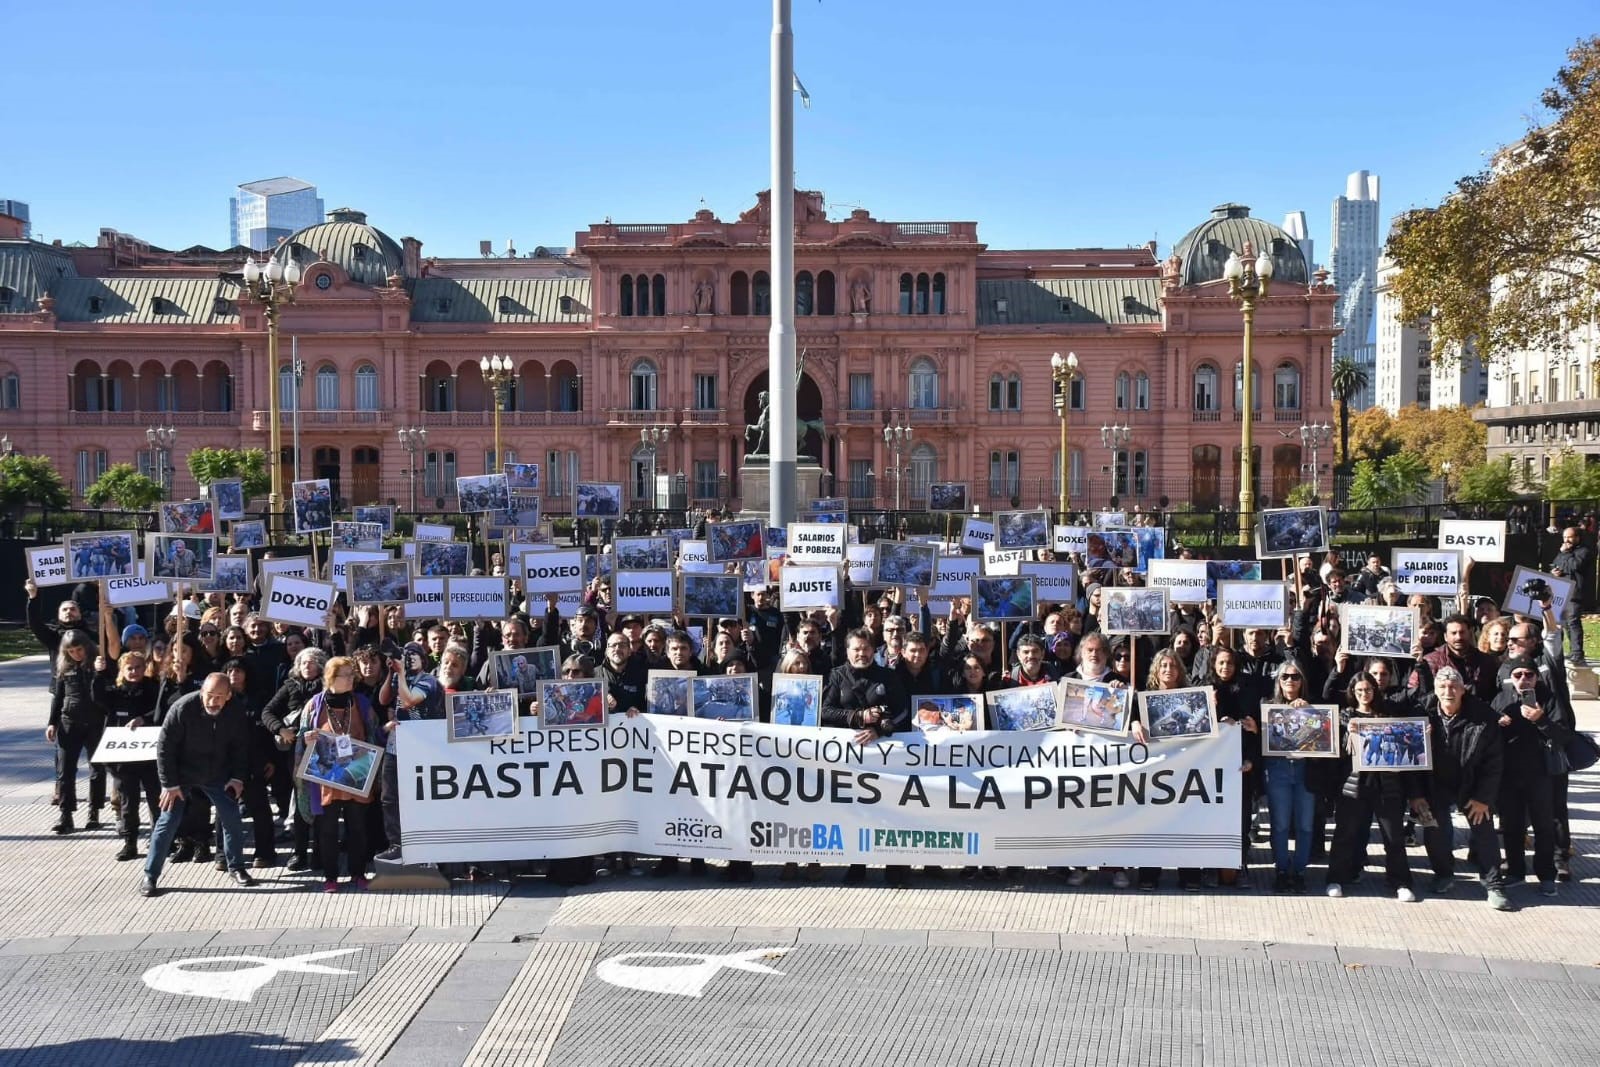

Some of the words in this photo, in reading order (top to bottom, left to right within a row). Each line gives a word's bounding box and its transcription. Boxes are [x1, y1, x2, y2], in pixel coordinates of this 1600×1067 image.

[798, 534, 835, 543] SALARIOS
[969, 530, 995, 541] AJUST
[1057, 536, 1087, 544] DOXE
[1446, 535, 1497, 546] BASTA
[793, 546, 803, 554] DE
[806, 546, 842, 555] POBREZA
[38, 556, 65, 567] SALAR
[1404, 562, 1448, 571] SALARIOS
[35, 569, 46, 578] DE
[527, 566, 580, 579] DOXEO
[937, 572, 977, 582] ENSURA
[1035, 576, 1071, 587] SECUCIÓN
[1153, 577, 1206, 588] HOSTIGAMIENTO
[1398, 575, 1410, 584] DE
[1414, 575, 1456, 585] POBREZA
[618, 586, 671, 597] VIOLENCIA
[790, 581, 832, 593] AJUSTE
[271, 591, 328, 611] DOXEO
[450, 591, 503, 603] PERSECUCIÓN
[1225, 600, 1282, 610] SILENCIAMIENTO
[490, 722, 657, 756] REPRESIÓN,
[669, 729, 863, 765] PERSECUCIÓN
[878, 743, 895, 766] Y
[905, 742, 1149, 768] SILENCIAMIENTO
[415, 760, 584, 801] ¡BASTA
[600, 757, 653, 794] DE
[669, 760, 882, 806] ATAQUES
[899, 774, 931, 808] A
[947, 775, 1007, 810] LA
[1024, 767, 1225, 810] PRENSA!
[750, 820, 844, 850] SiPreBA
[874, 828, 964, 849] FATPREN
